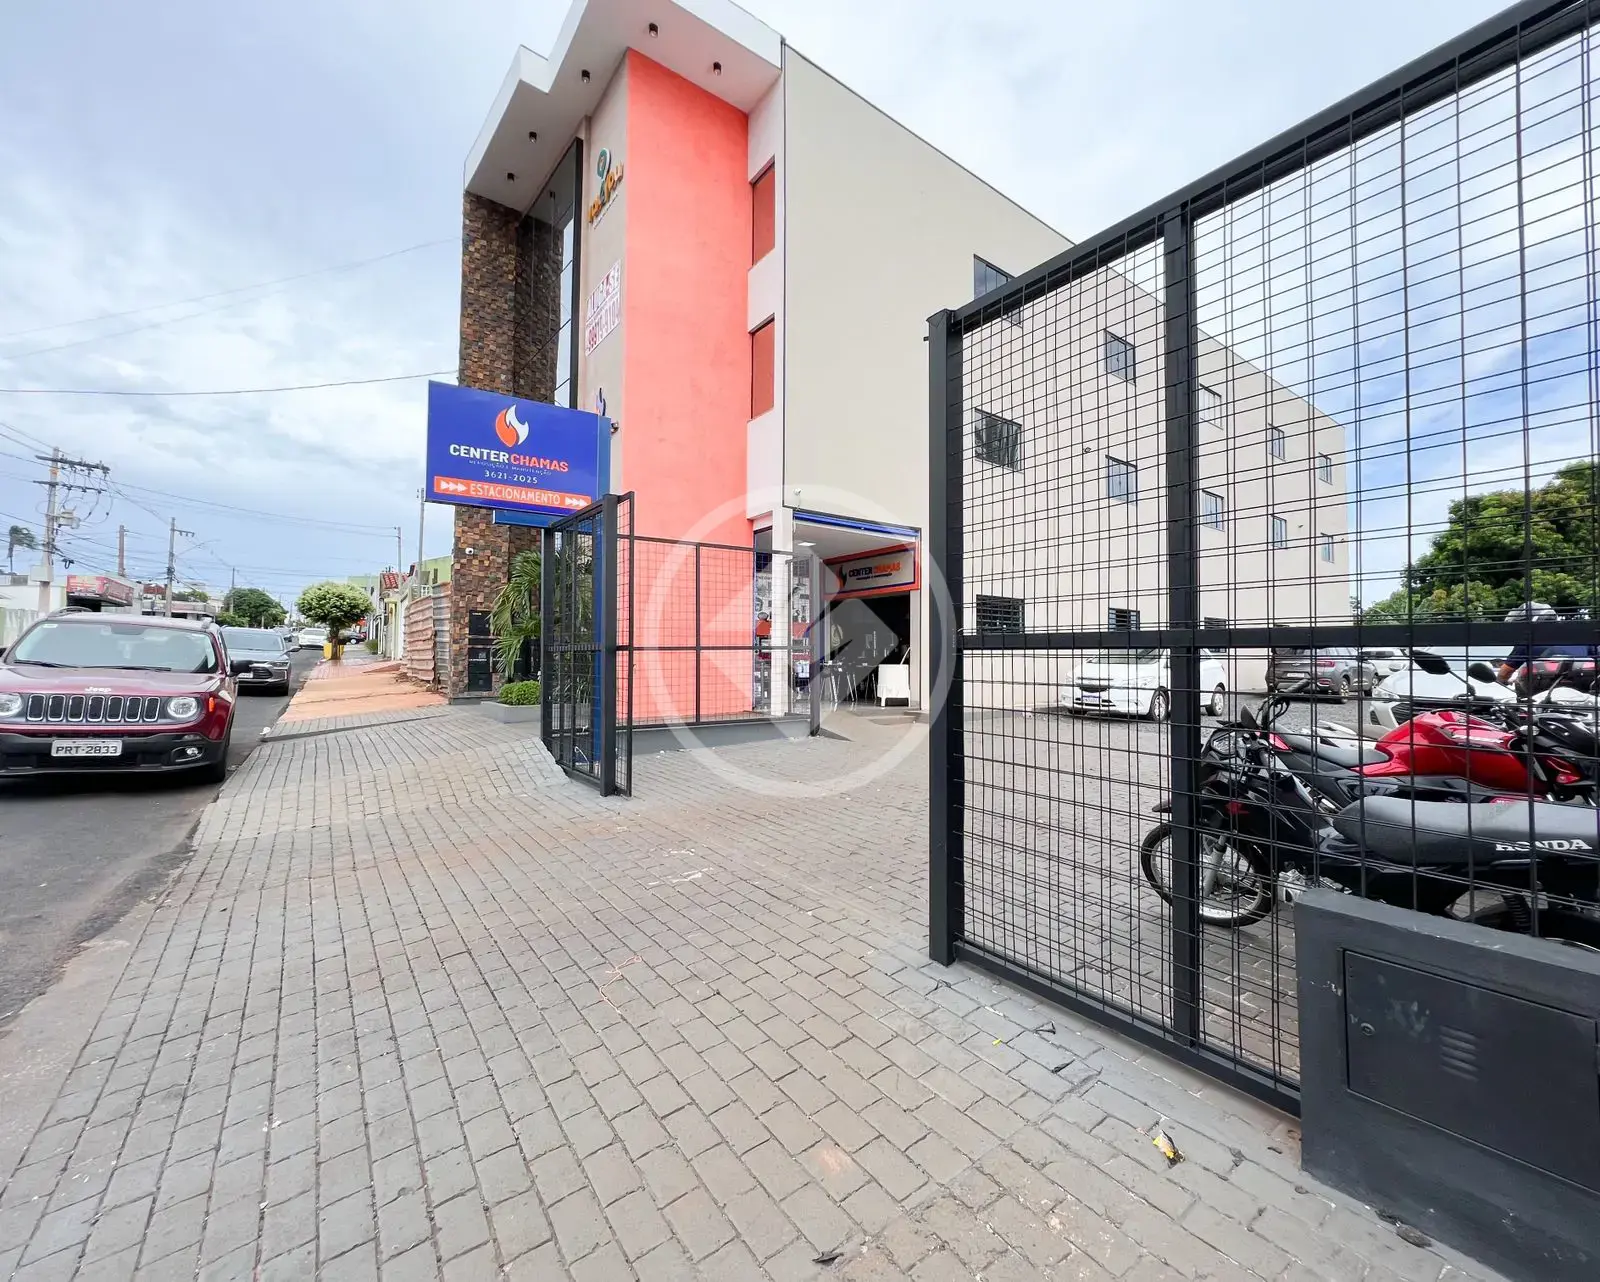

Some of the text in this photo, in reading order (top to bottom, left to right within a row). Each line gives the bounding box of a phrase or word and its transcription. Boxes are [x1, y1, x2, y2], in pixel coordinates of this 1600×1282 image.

[449, 444, 509, 464] CENTER
[510, 453, 569, 472] CHAMAS
[485, 470, 538, 484] 3621-2025
[470, 484, 560, 505] ESTACIONAMENTO
[55, 745, 118, 755] PRT-2833
[1495, 839, 1593, 852] HONDA
